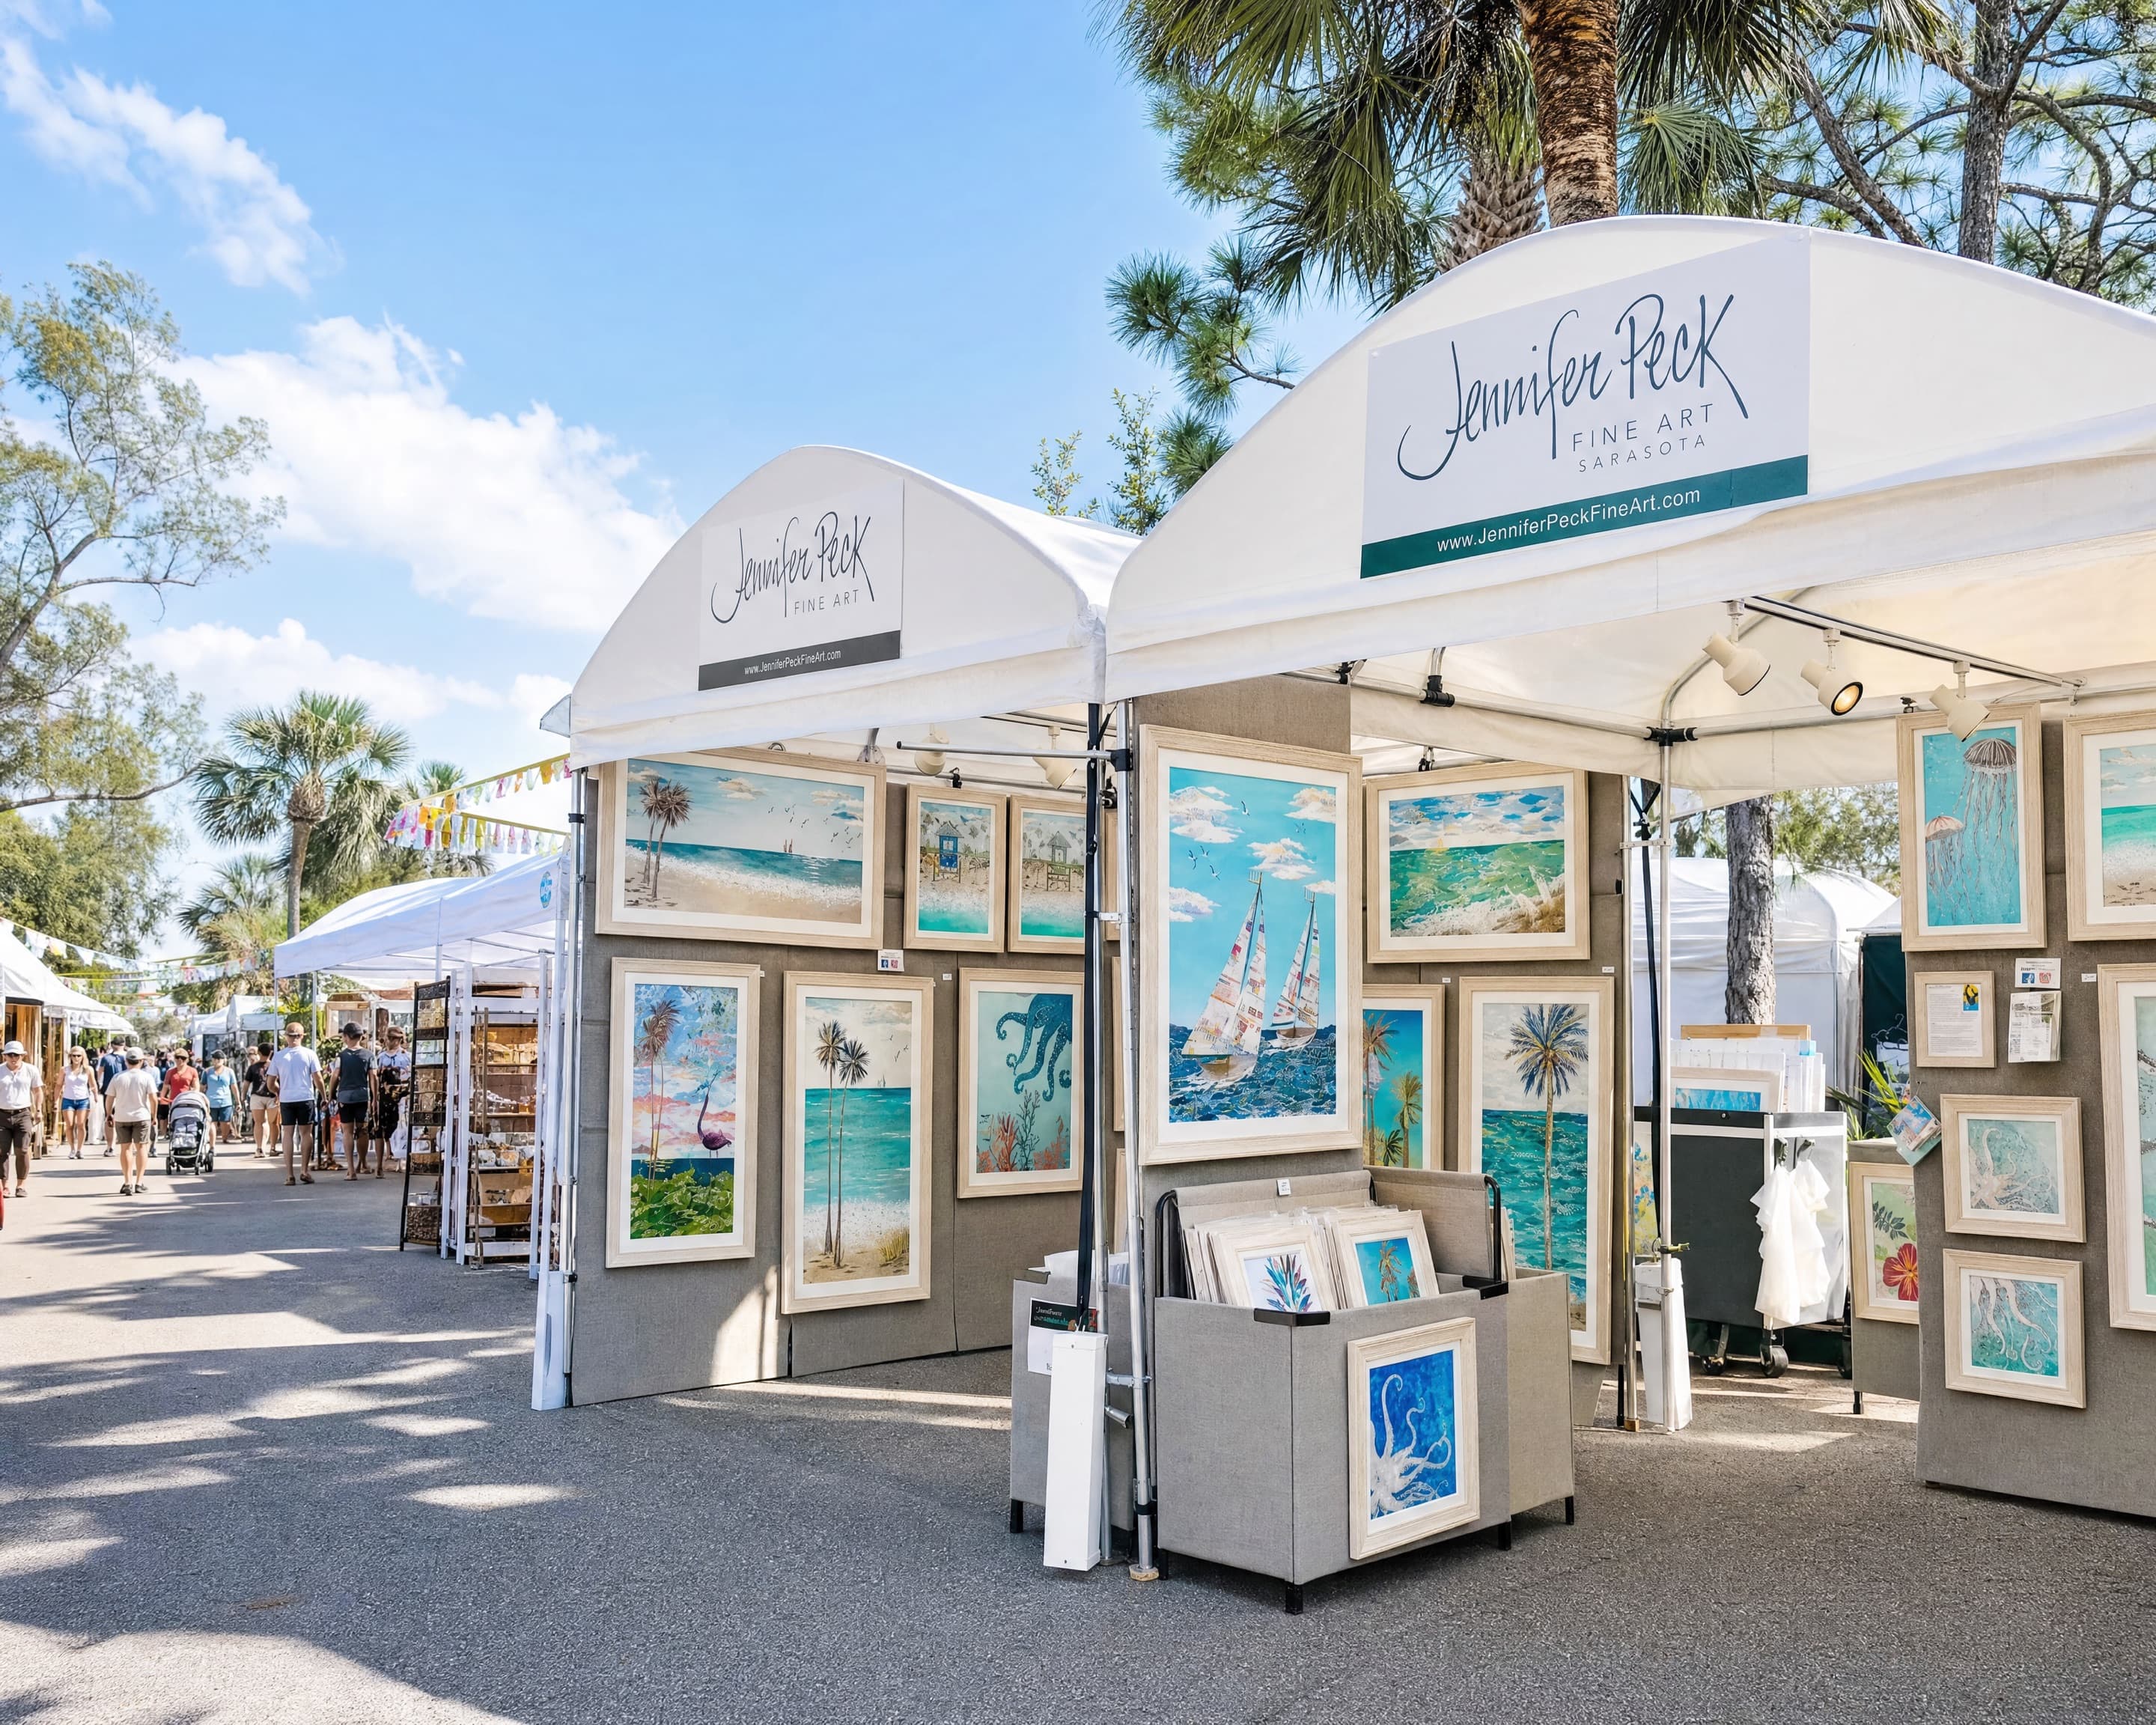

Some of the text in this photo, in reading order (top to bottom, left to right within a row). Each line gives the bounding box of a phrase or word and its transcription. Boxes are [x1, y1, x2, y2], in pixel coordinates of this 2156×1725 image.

[1397, 293, 1749, 481] Jennifer Peck
[1573, 403, 1714, 452] FINE ART
[1579, 434, 1705, 472] SARASOTA
[1437, 488, 1701, 553] www.JenniferPeckFineArt.com
[710, 511, 875, 624] Jennifer Peck
[794, 589, 859, 615] FINE ART
[744, 648, 841, 675] www.JenniferPeckFineArt.com
